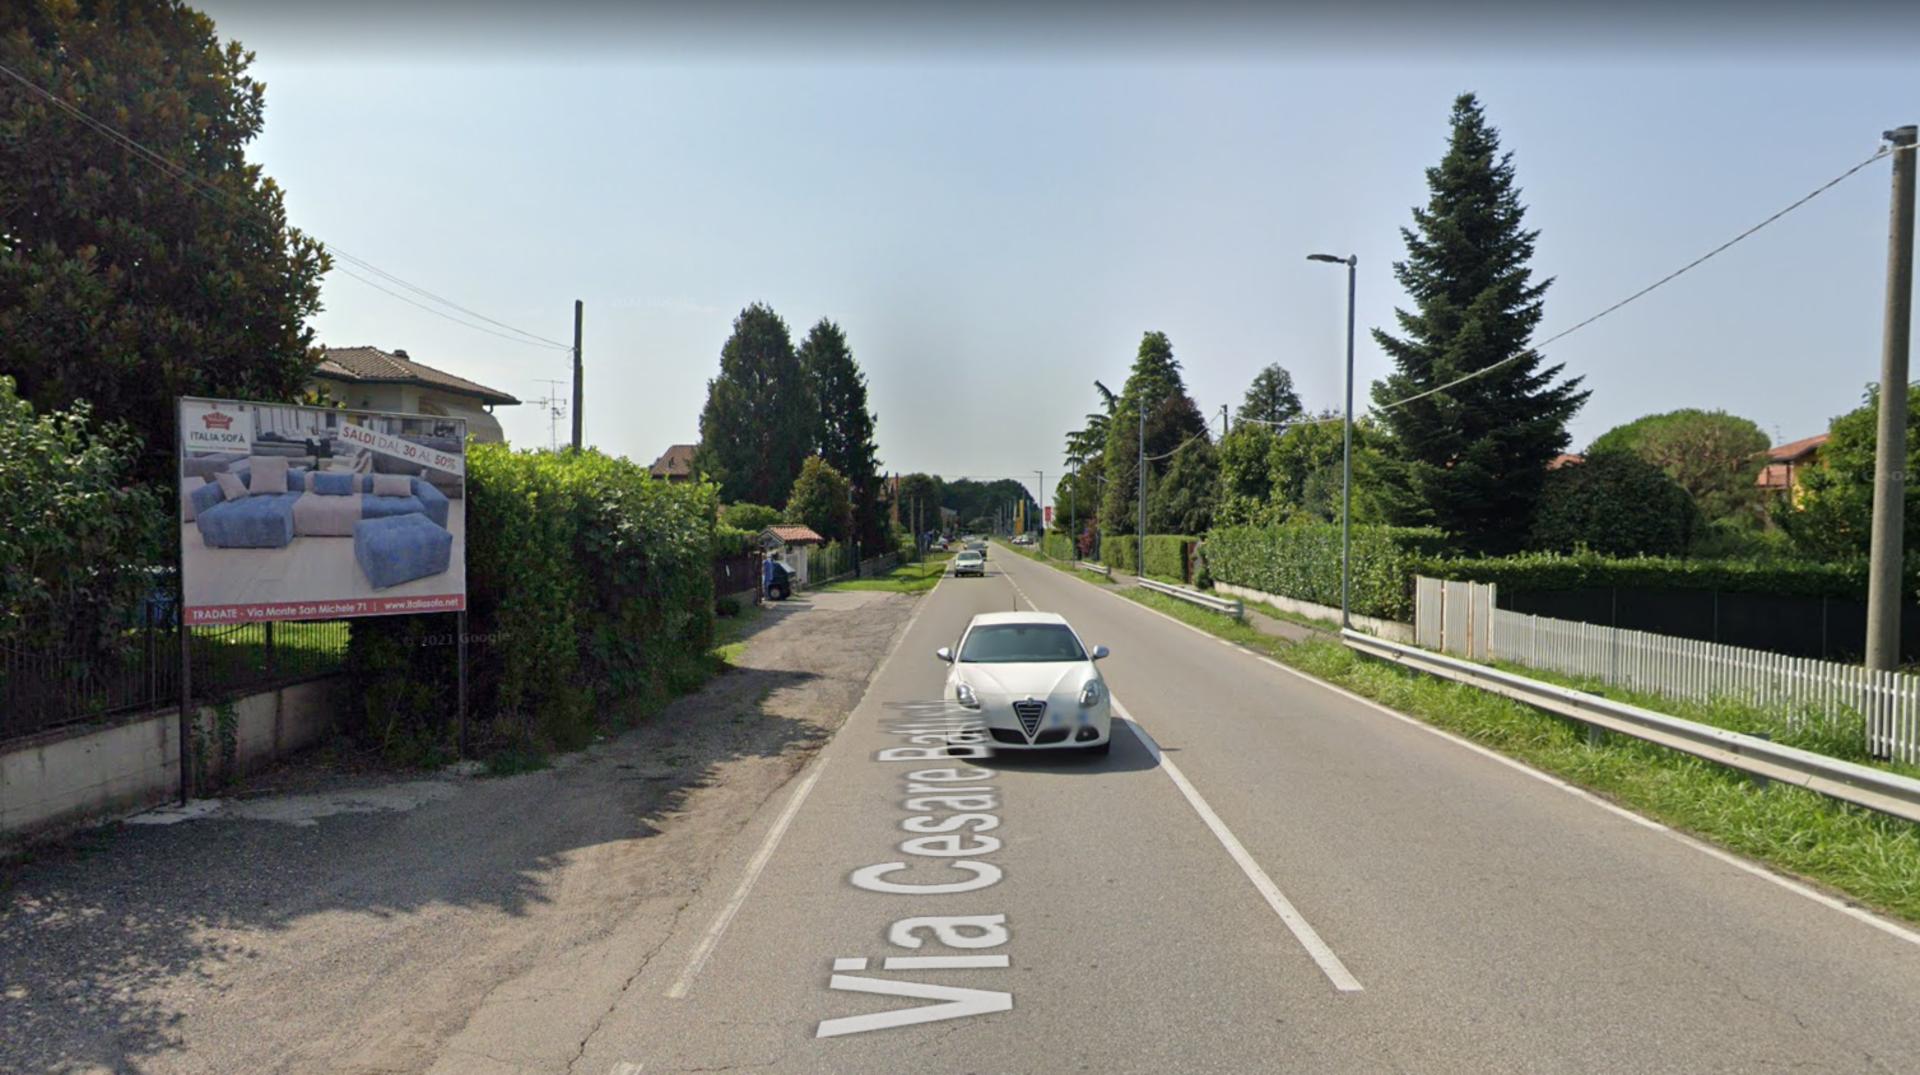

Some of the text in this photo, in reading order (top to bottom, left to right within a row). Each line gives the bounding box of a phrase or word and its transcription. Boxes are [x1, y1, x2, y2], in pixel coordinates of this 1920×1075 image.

[190, 431, 219, 441] ITALIA
[343, 426, 457, 470] SALDI DAL 30 AL 50%
[193, 608, 238, 619] TRADATE
[247, 607, 264, 617] Via
[266, 606, 296, 616] Monte
[299, 605, 317, 615] San
[319, 603, 354, 614] Michele
[384, 598, 458, 610] www.italiasofa.net
